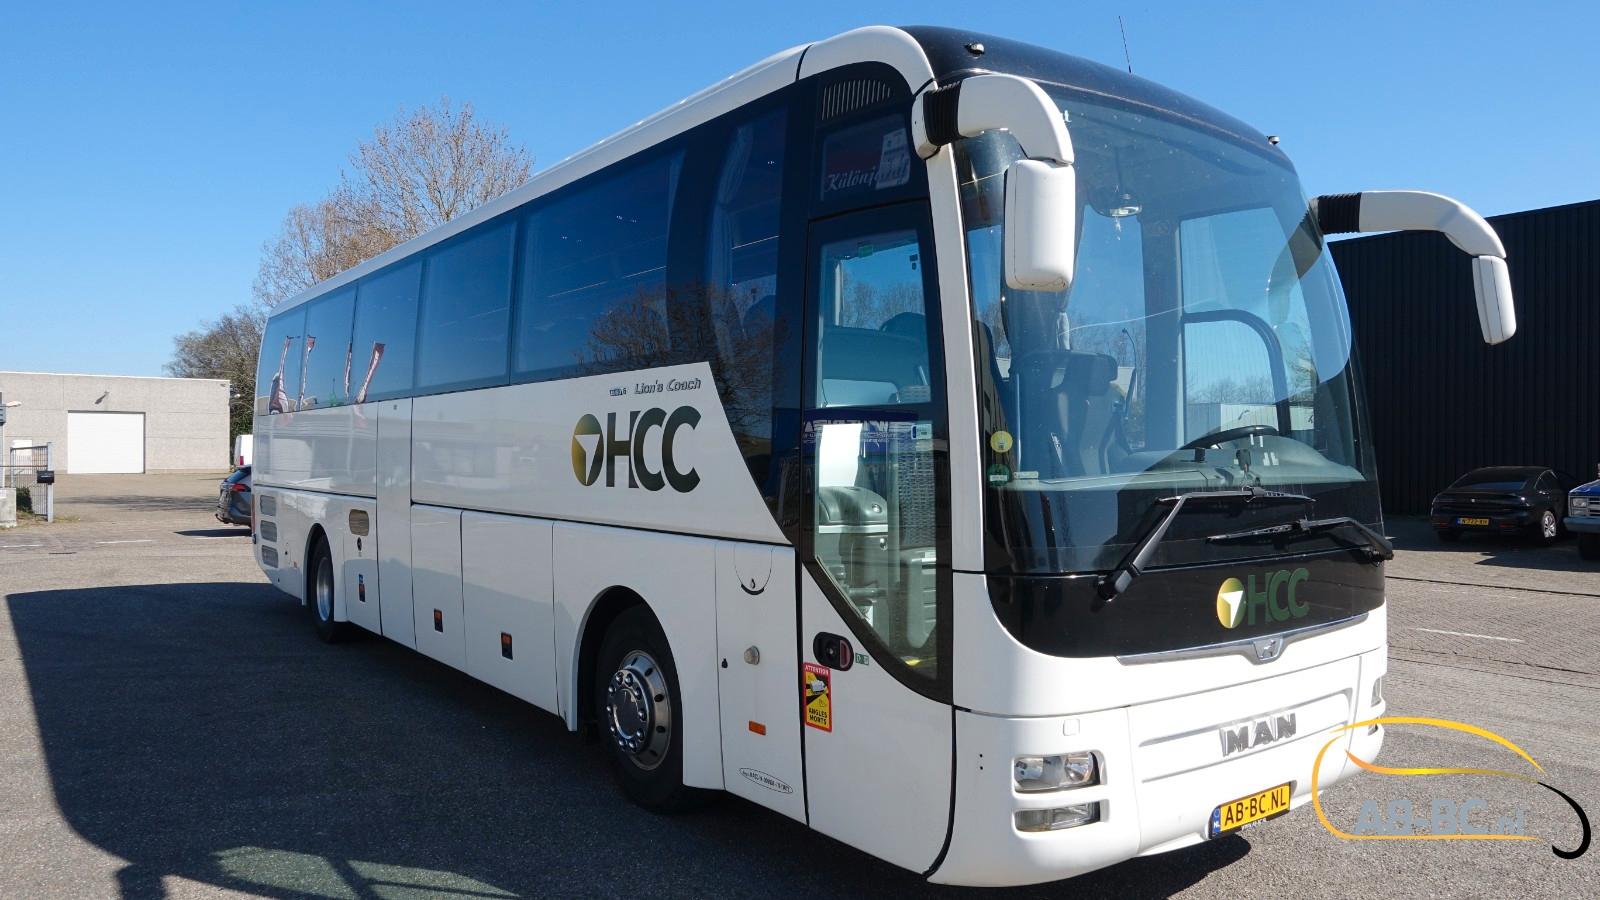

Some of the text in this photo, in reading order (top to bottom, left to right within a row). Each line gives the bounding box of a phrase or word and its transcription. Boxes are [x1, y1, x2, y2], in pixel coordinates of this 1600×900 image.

[633, 380, 664, 395] Lion's
[666, 378, 702, 392] Coach
[805, 664, 829, 676] ATTENTION
[809, 707, 828, 719] ANGLES
[809, 714, 827, 726] MORTS
[1219, 712, 1297, 757] MAN
